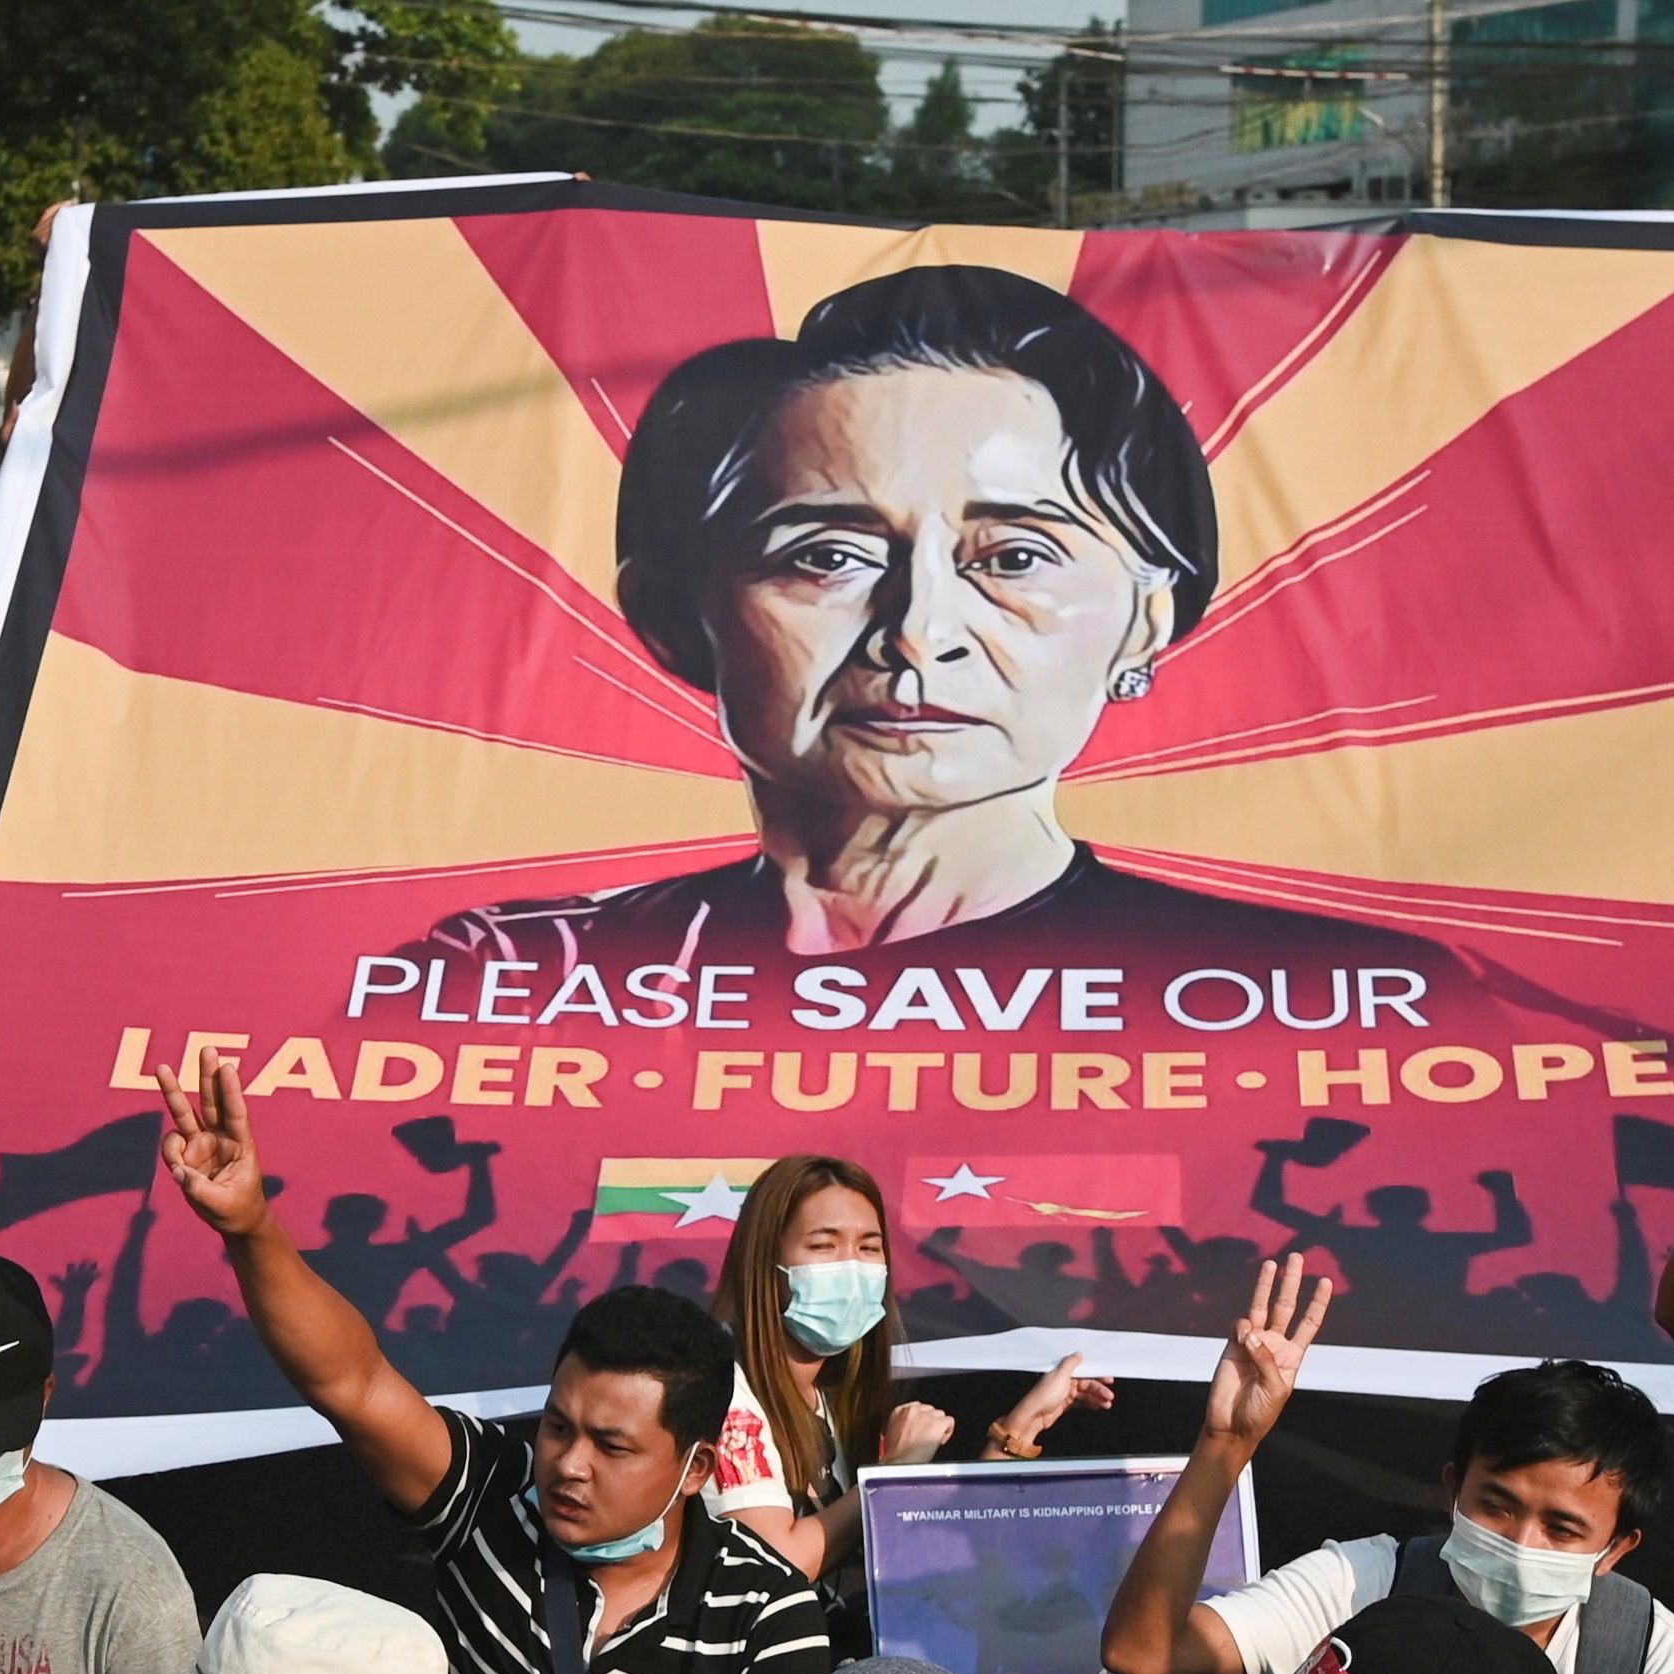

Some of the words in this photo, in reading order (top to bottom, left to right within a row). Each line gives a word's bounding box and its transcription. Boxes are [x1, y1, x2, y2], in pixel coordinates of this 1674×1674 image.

[347, 954, 756, 1030] PLEASE
[791, 965, 1125, 1032] SAVE
[1162, 967, 1431, 1032] OUR
[109, 1026, 610, 1109] LEADER
[692, 1050, 1208, 1112] FUTURE
[964, 1508, 1016, 1520] MILITARY
[1019, 1508, 1031, 1519] IS
[1033, 1506, 1104, 1518] KIDNAPPING
[1106, 1504, 1153, 1516] PEOPLE
